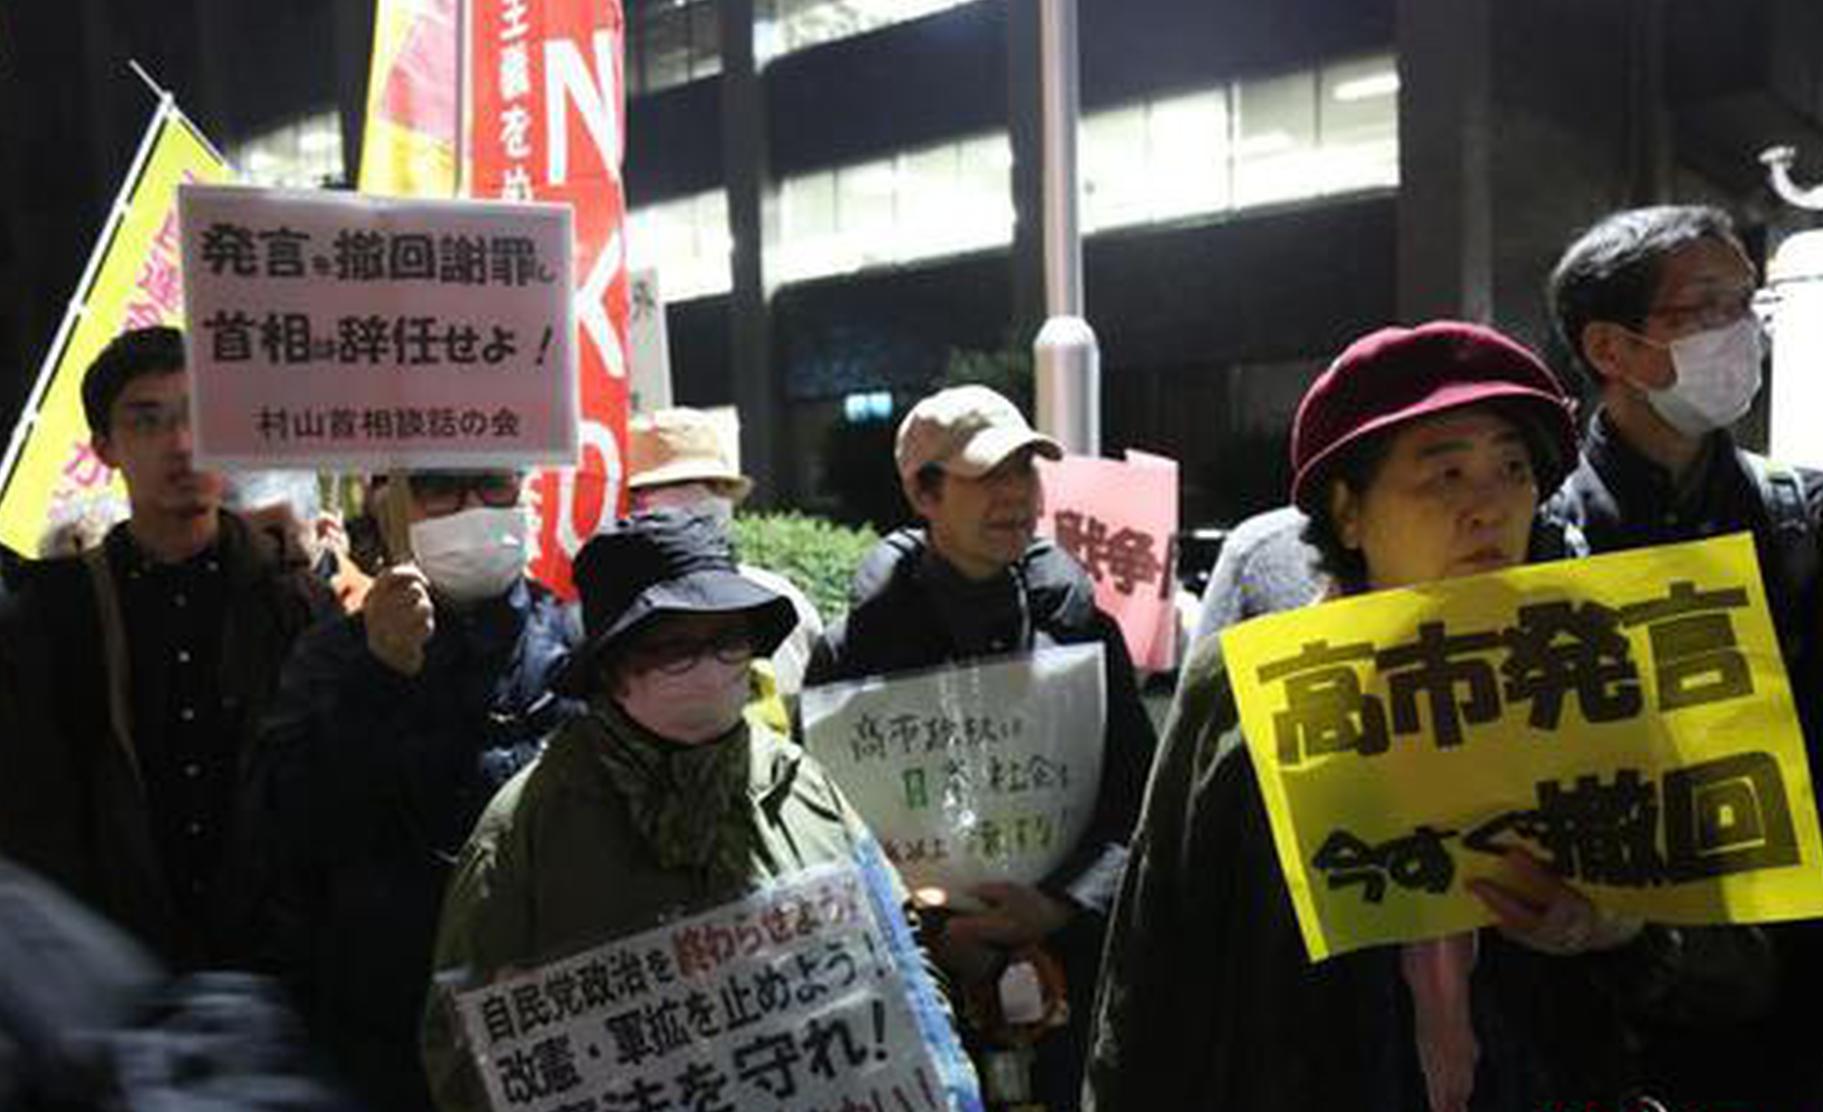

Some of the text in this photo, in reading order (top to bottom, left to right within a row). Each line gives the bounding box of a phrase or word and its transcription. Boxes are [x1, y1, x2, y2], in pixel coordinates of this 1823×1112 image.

[202, 223, 556, 286] 発言を撤回謝罪し
[203, 310, 553, 365] 首相は辞任せよ！
[258, 405, 520, 441] 村山首相談話の会
[1257, 581, 1755, 765] 高市発言
[497, 930, 887, 1105] 改憲・軍拡を止めよう！
[550, 1000, 887, 1112] 法を守れ！
